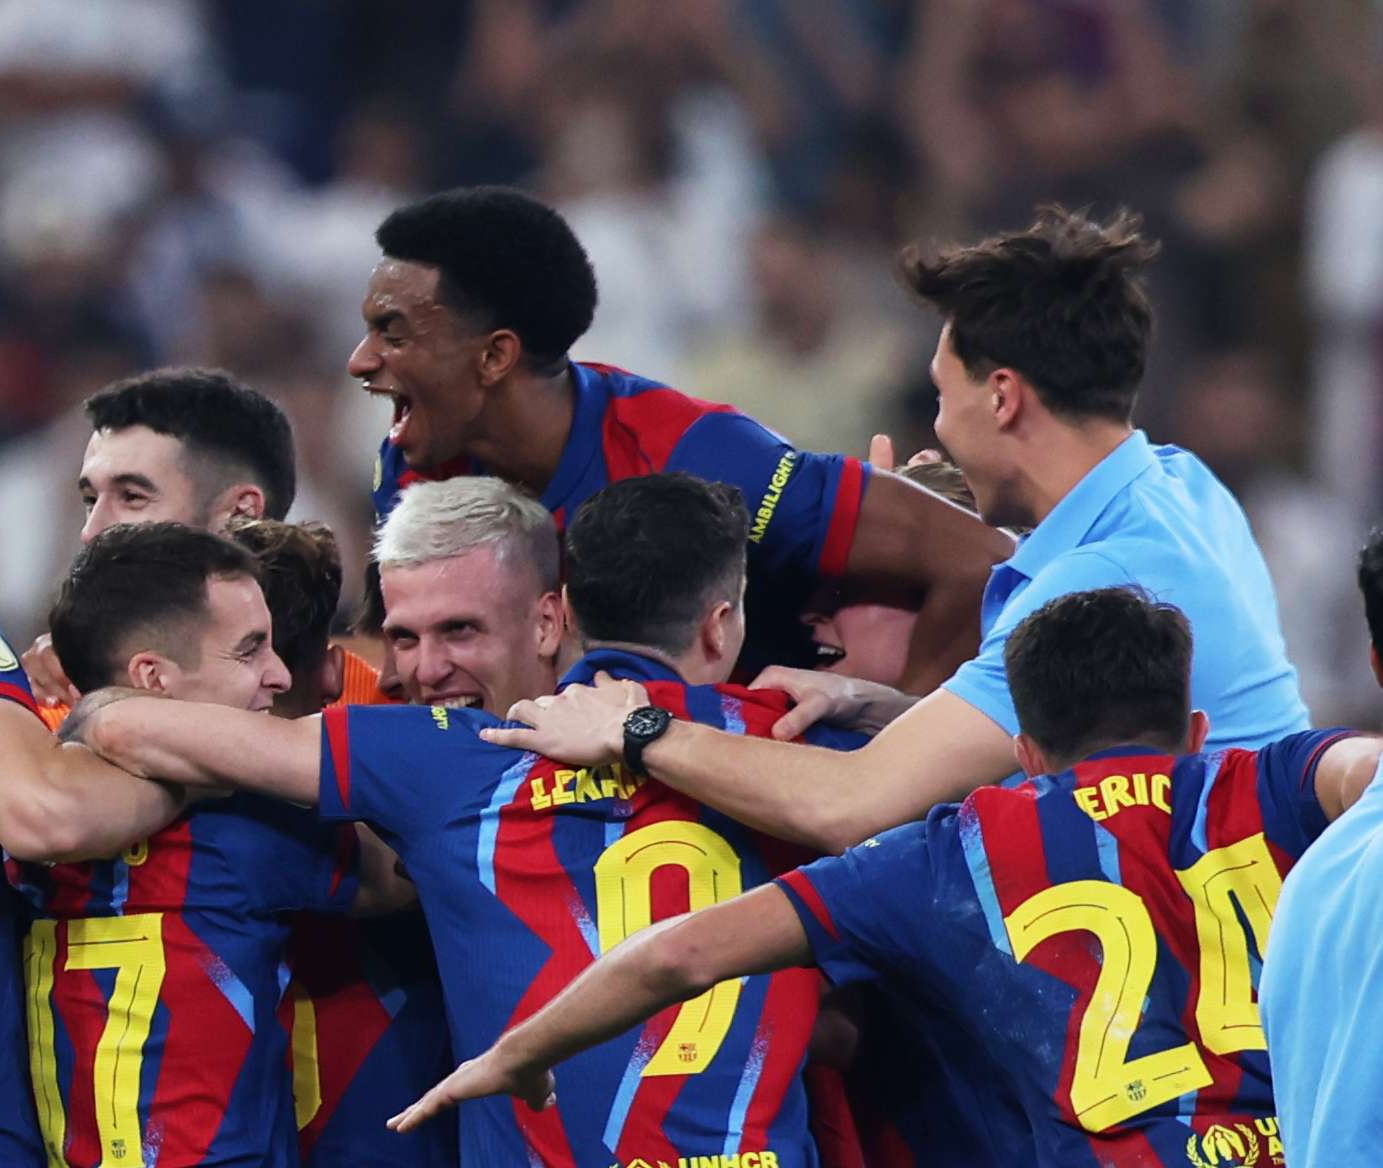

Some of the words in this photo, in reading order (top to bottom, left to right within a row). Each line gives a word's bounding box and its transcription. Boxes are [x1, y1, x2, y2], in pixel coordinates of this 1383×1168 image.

[748, 457, 794, 543] AMBILIGHT
[1073, 773, 1172, 821] ERIC
[594, 821, 742, 1077] 9
[1004, 833, 1284, 1133] 24
